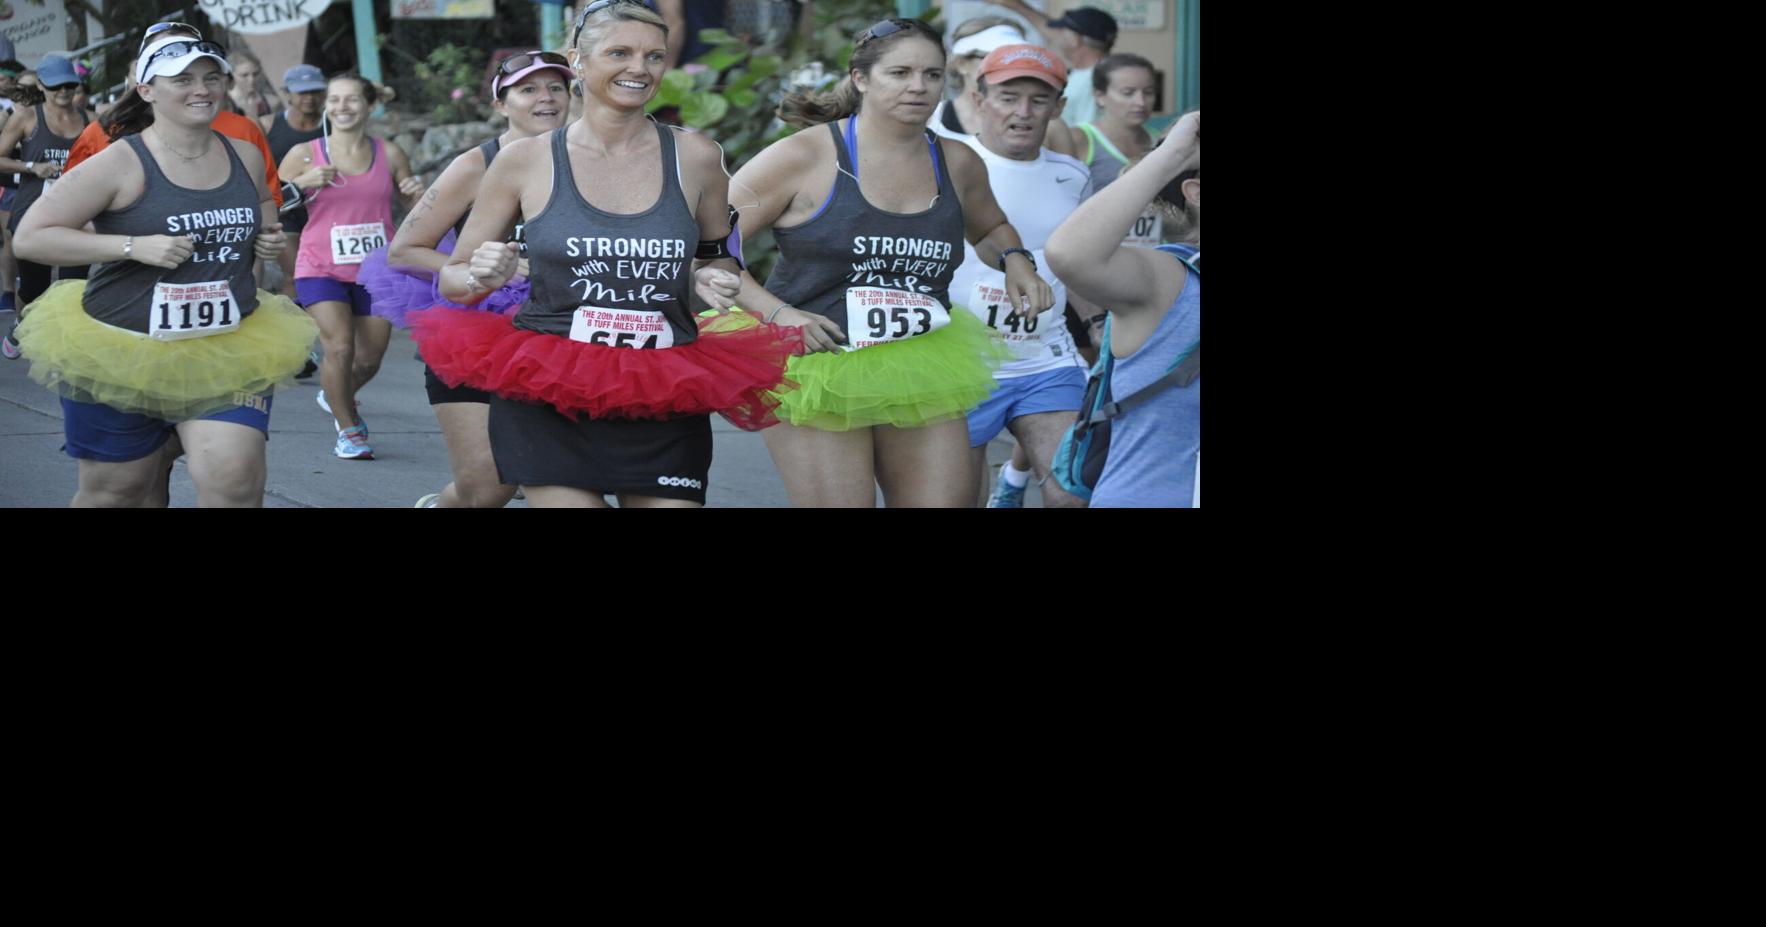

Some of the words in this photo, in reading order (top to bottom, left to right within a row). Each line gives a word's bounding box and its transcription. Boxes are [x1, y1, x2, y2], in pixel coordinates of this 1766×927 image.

[223, 0, 312, 27] DRINK
[44, 149, 69, 158] STRO
[166, 207, 255, 232] STRONGER
[204, 226, 254, 244] EVERY
[336, 235, 384, 256] 1260
[566, 237, 686, 259] STRONGER
[852, 235, 953, 261] STRONGER
[571, 259, 610, 277] with
[616, 260, 683, 280] EVERY
[851, 257, 887, 272] with
[890, 258, 948, 278] EVERY
[854, 290, 868, 298] THE
[885, 291, 909, 300] ANNUAL
[867, 298, 884, 306] TUFF
[885, 298, 903, 307] MILES
[904, 299, 934, 308] FESTIVAL
[158, 299, 233, 330] 1191
[582, 309, 596, 318] THE
[615, 313, 643, 323] ANNUAL
[867, 307, 932, 339] 953
[594, 320, 612, 329] TUFF
[613, 322, 635, 331] MILES
[636, 324, 665, 332] FESTIVAL
